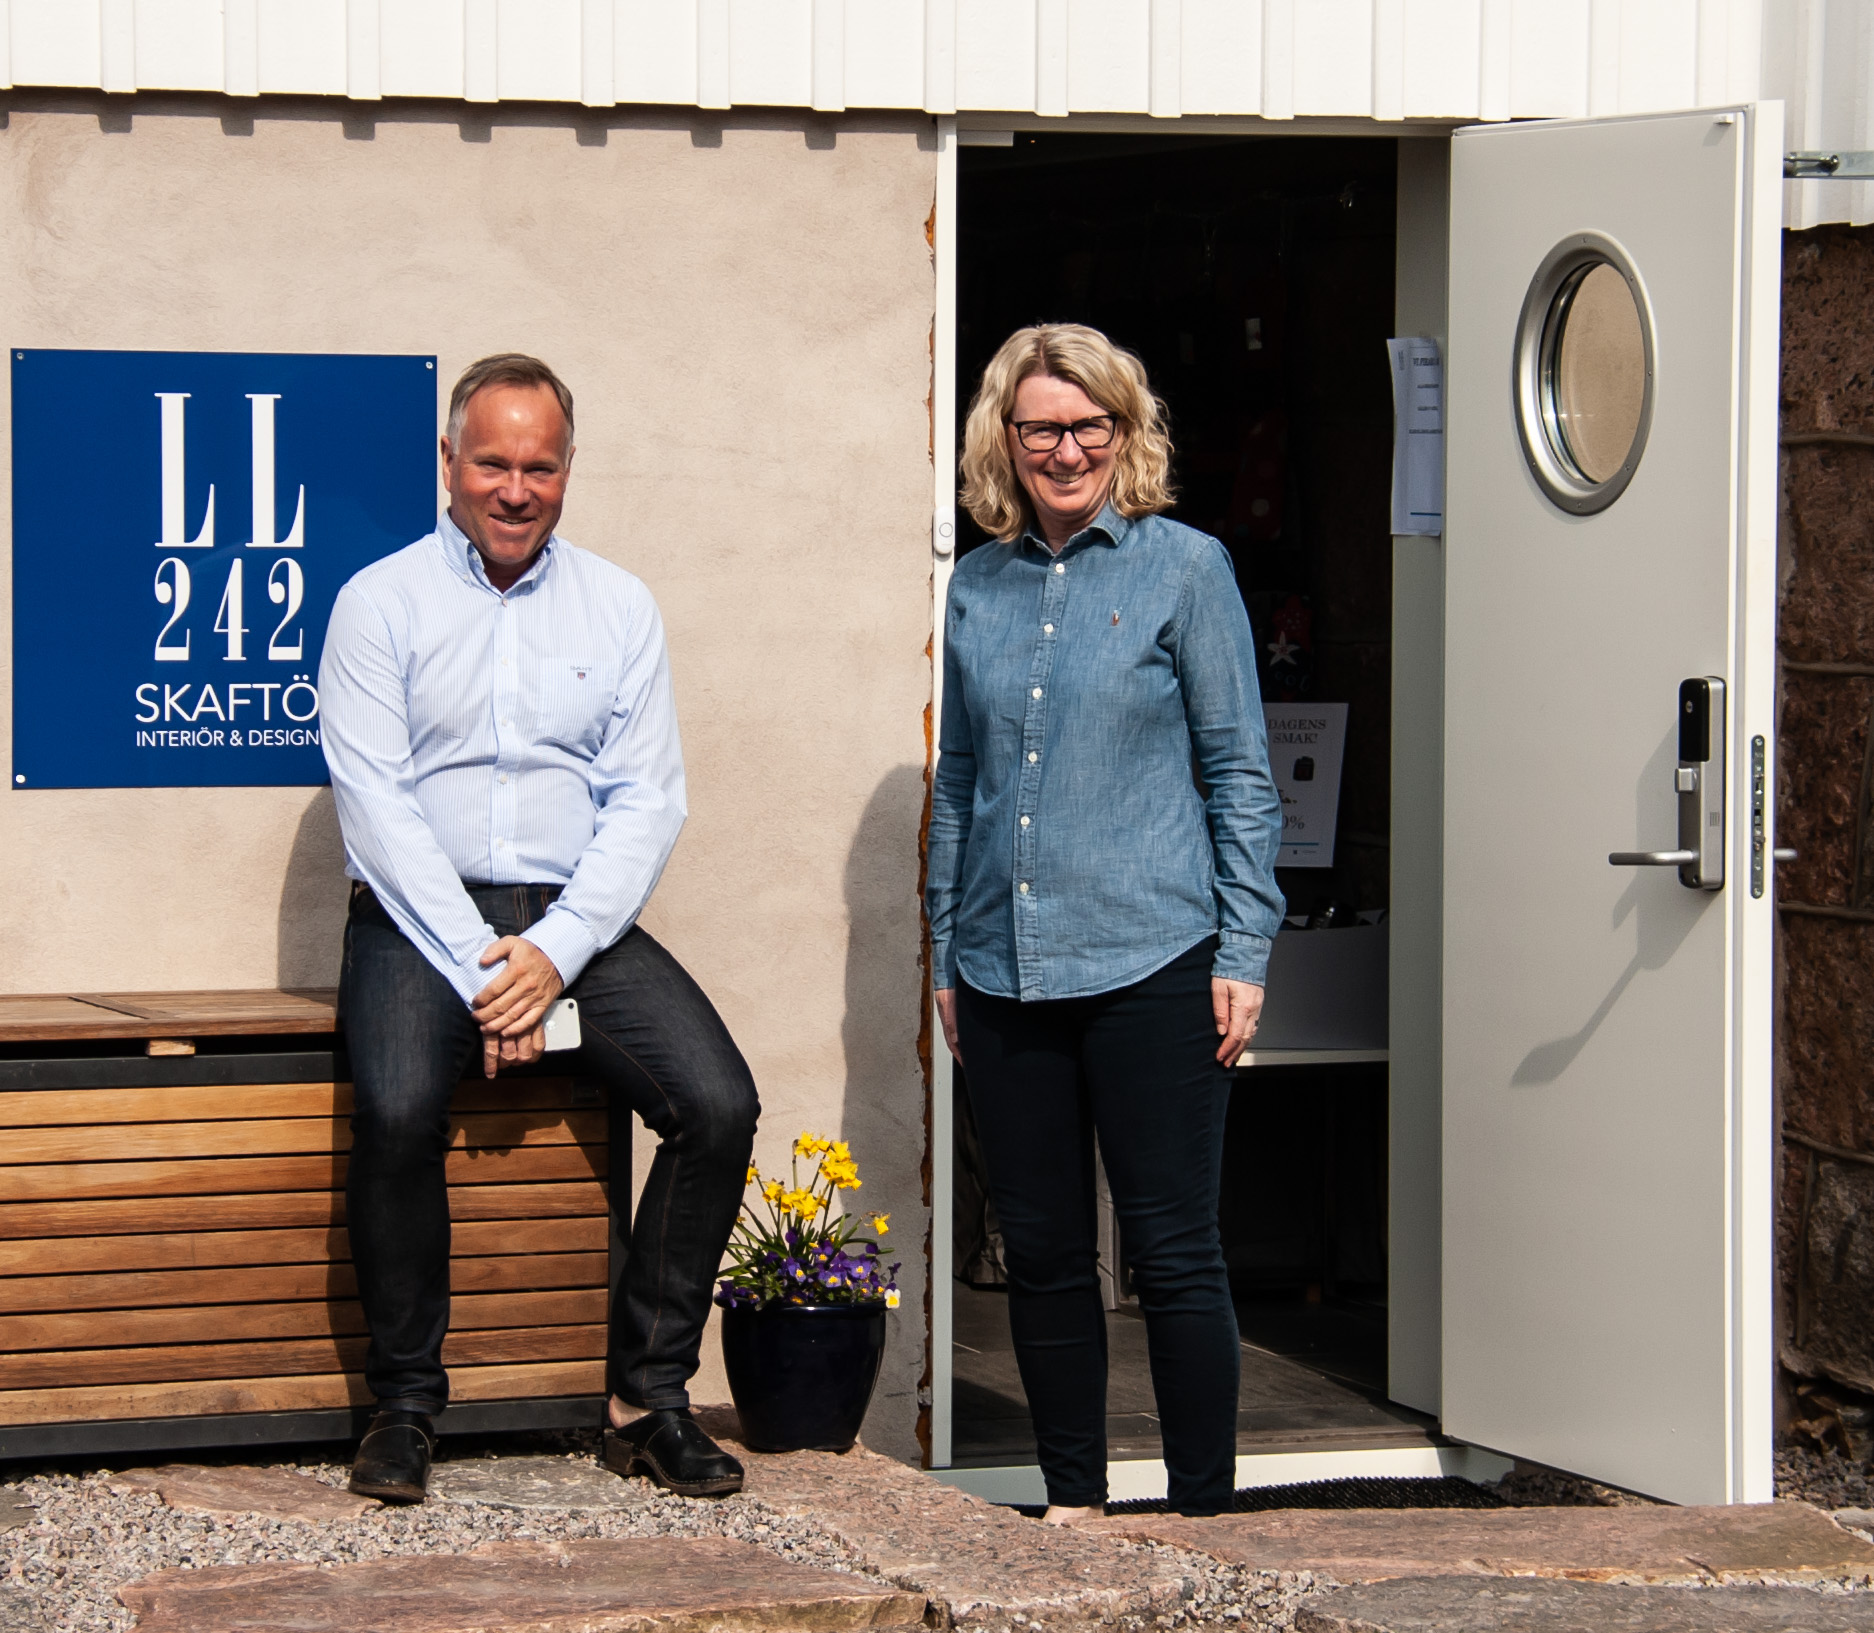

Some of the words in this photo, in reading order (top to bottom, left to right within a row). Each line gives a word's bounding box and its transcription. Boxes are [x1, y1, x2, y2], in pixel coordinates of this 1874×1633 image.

[154, 557, 304, 662] 242
[135, 674, 319, 723] SKAFTÖ
[1268, 718, 1327, 731] DAGENS
[136, 726, 225, 747] INTERIÖR
[229, 729, 243, 747] &
[248, 729, 320, 746] DESIGN
[1272, 732, 1318, 744] SMAK!
